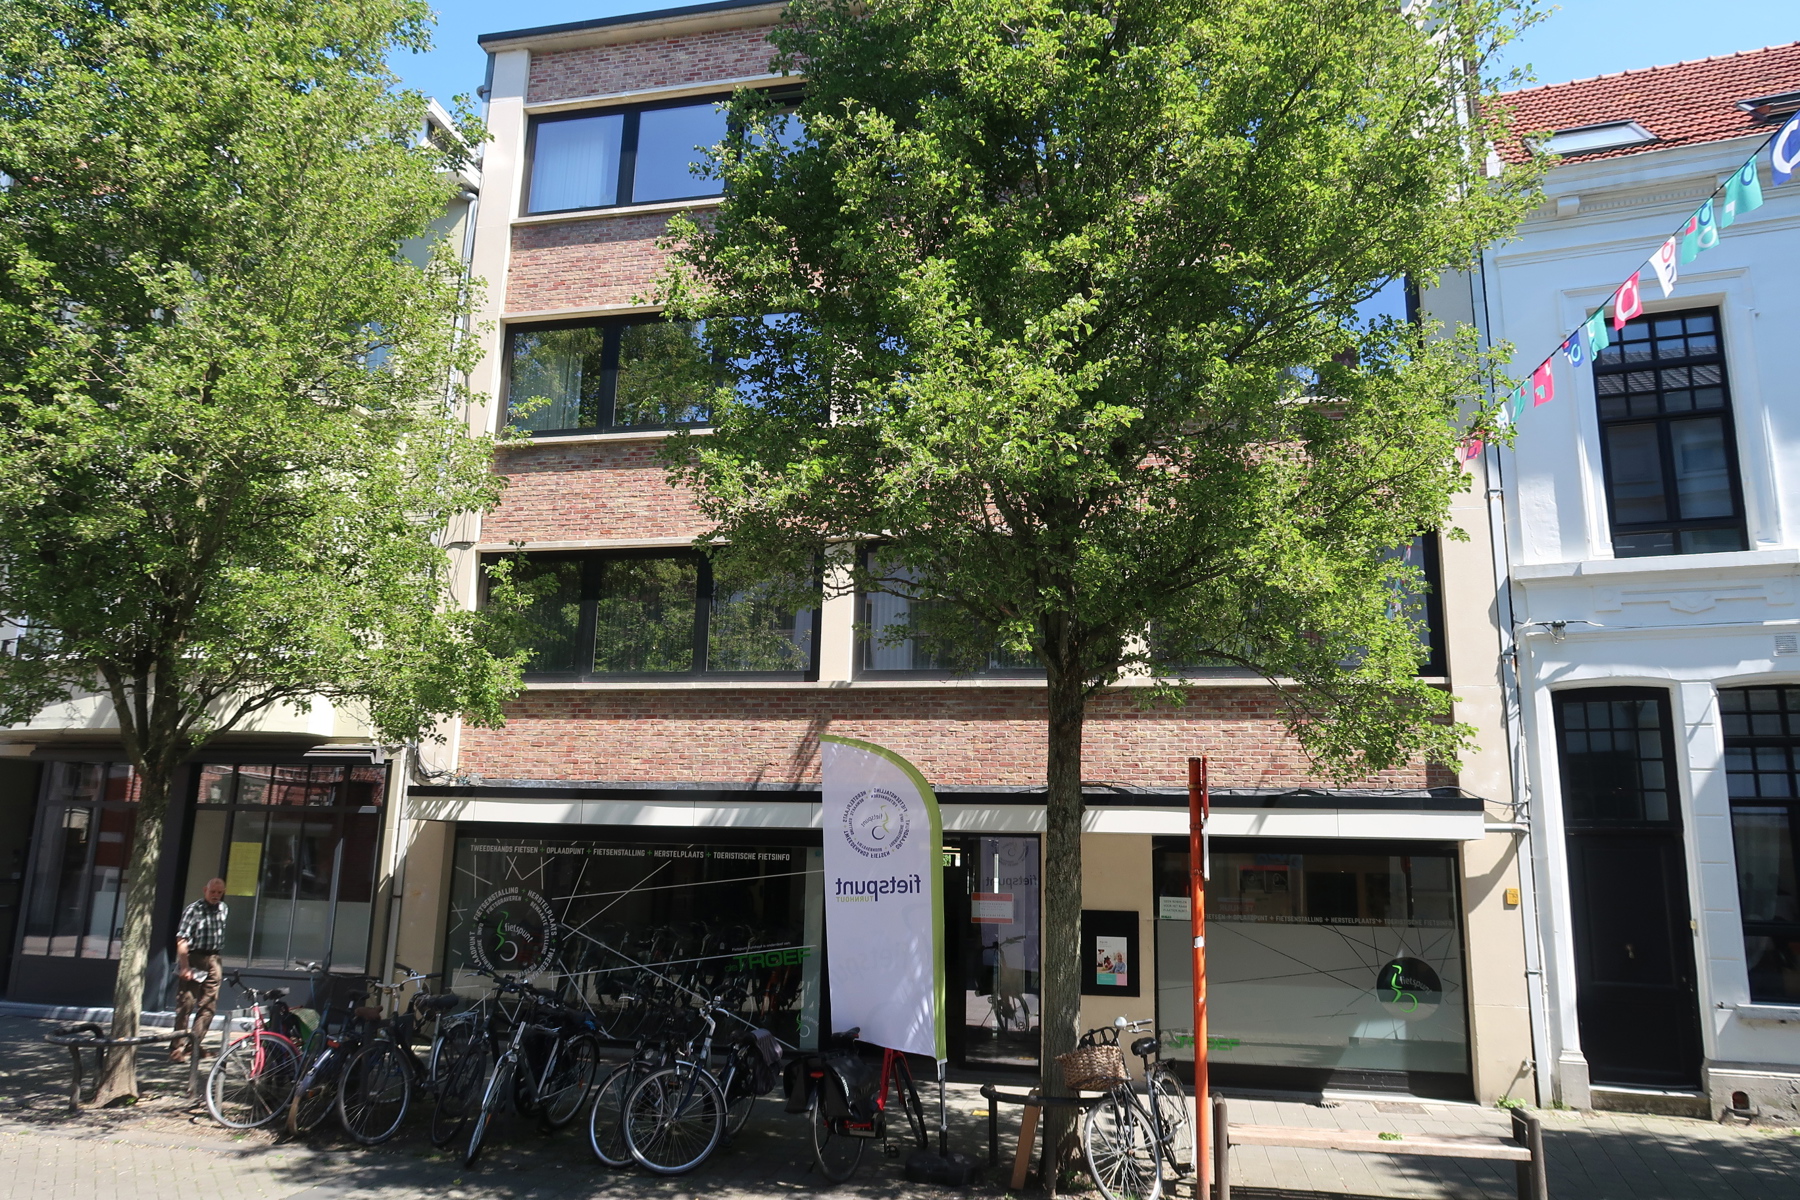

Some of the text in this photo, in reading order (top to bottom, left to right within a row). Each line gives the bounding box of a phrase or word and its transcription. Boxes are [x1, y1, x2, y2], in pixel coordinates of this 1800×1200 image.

[470, 844, 790, 861] TWEEDEHANDS FIETSEN OPLAADPUNT FIETSENSTALLING HERSTELPLAATS TOERISTISCHE FIETSINFO
[473, 886, 519, 921] FIETSENSTALLING
[527, 890, 558, 936] HERSTELPLAATS
[1276, 915, 1323, 923] FIETSENSTALLING
[504, 923, 534, 943] fietspunt
[732, 948, 811, 972] TROEF
[1399, 976, 1433, 996] fietspunt
